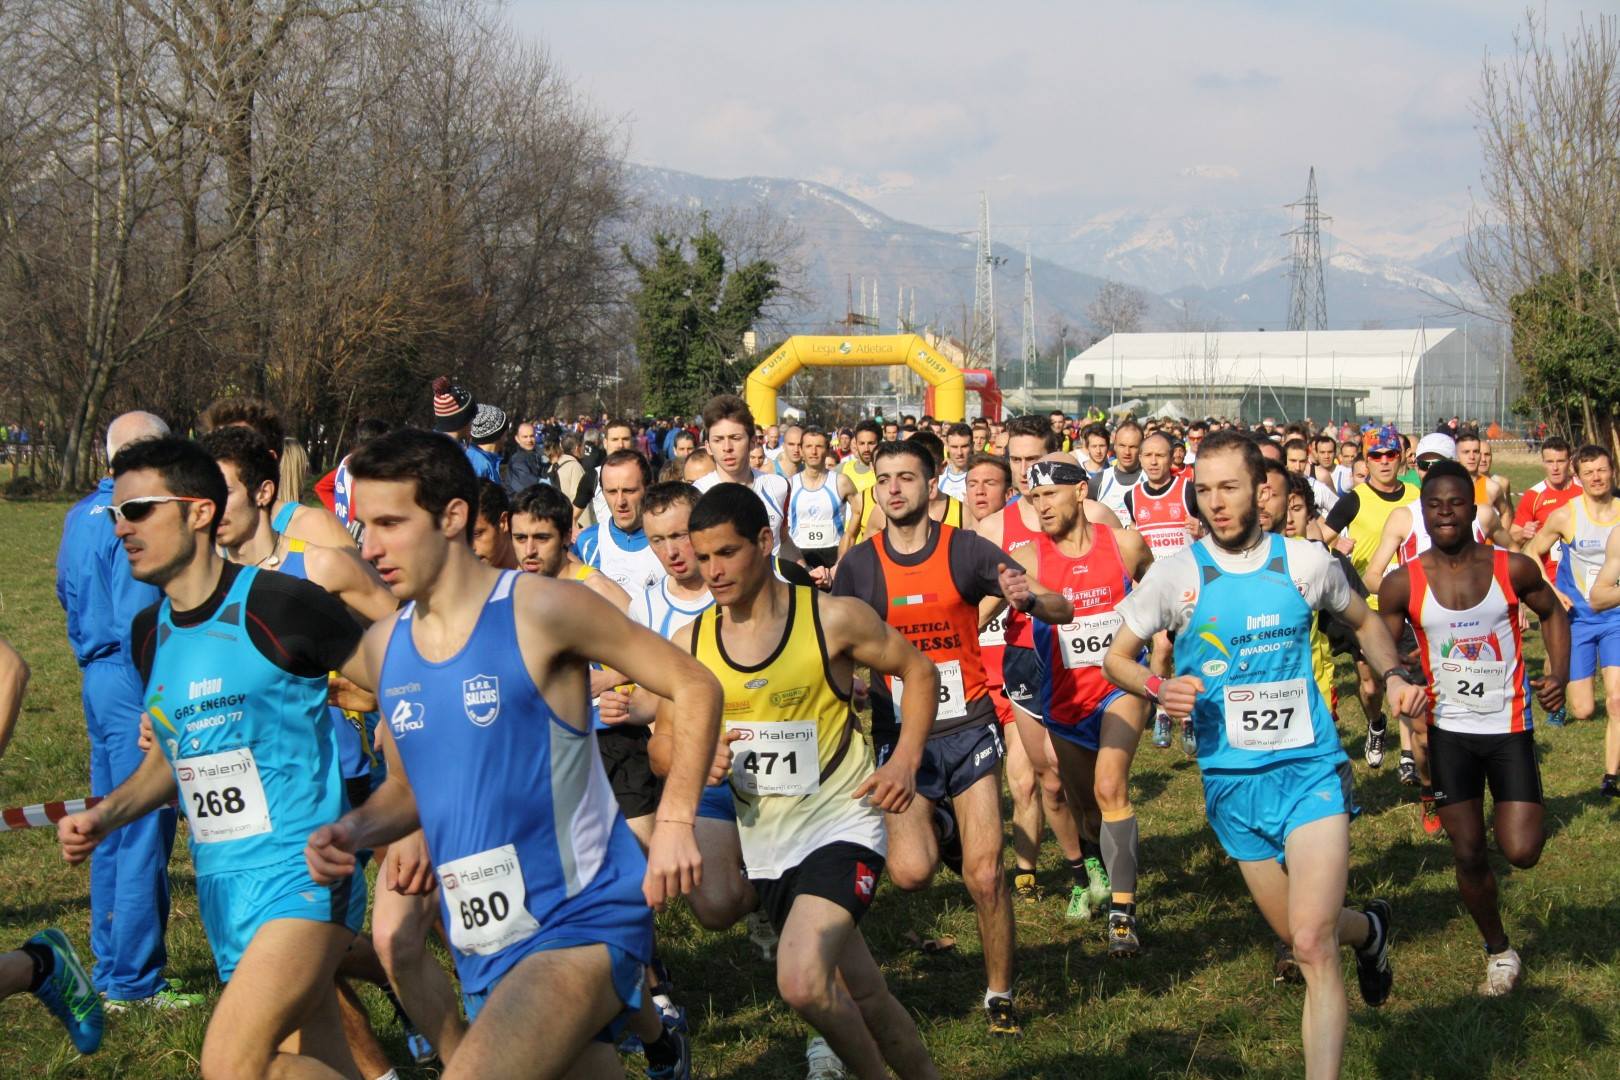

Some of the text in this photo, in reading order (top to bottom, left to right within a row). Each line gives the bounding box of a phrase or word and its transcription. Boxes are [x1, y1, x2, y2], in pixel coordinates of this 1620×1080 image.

[812, 343, 893, 354] Lega Atletica
[768, 350, 788, 368] UISP
[926, 357, 946, 374] UISP
[808, 531, 823, 541] 89
[1075, 588, 1107, 600] ATHLETIC
[1082, 598, 1100, 608] TEAM
[895, 620, 951, 635] TLETICA
[1247, 613, 1280, 630] Durbano
[1071, 632, 1113, 654] 964
[1230, 626, 1297, 646] GAS ENERGY
[1240, 643, 1281, 657] RIVAROLO
[465, 689, 497, 706] SALCUS
[1259, 687, 1304, 700] Kalenji
[1457, 680, 1485, 698] 24
[174, 693, 247, 721] GAS ENERGY
[186, 714, 226, 733] RIVAROLO
[1242, 707, 1295, 731] 527
[759, 728, 814, 742] Kalenji
[197, 758, 252, 778] Kalenji
[743, 750, 798, 775] 471
[192, 786, 246, 818] 268
[460, 858, 515, 883] Kalenji
[460, 891, 509, 930] 680
